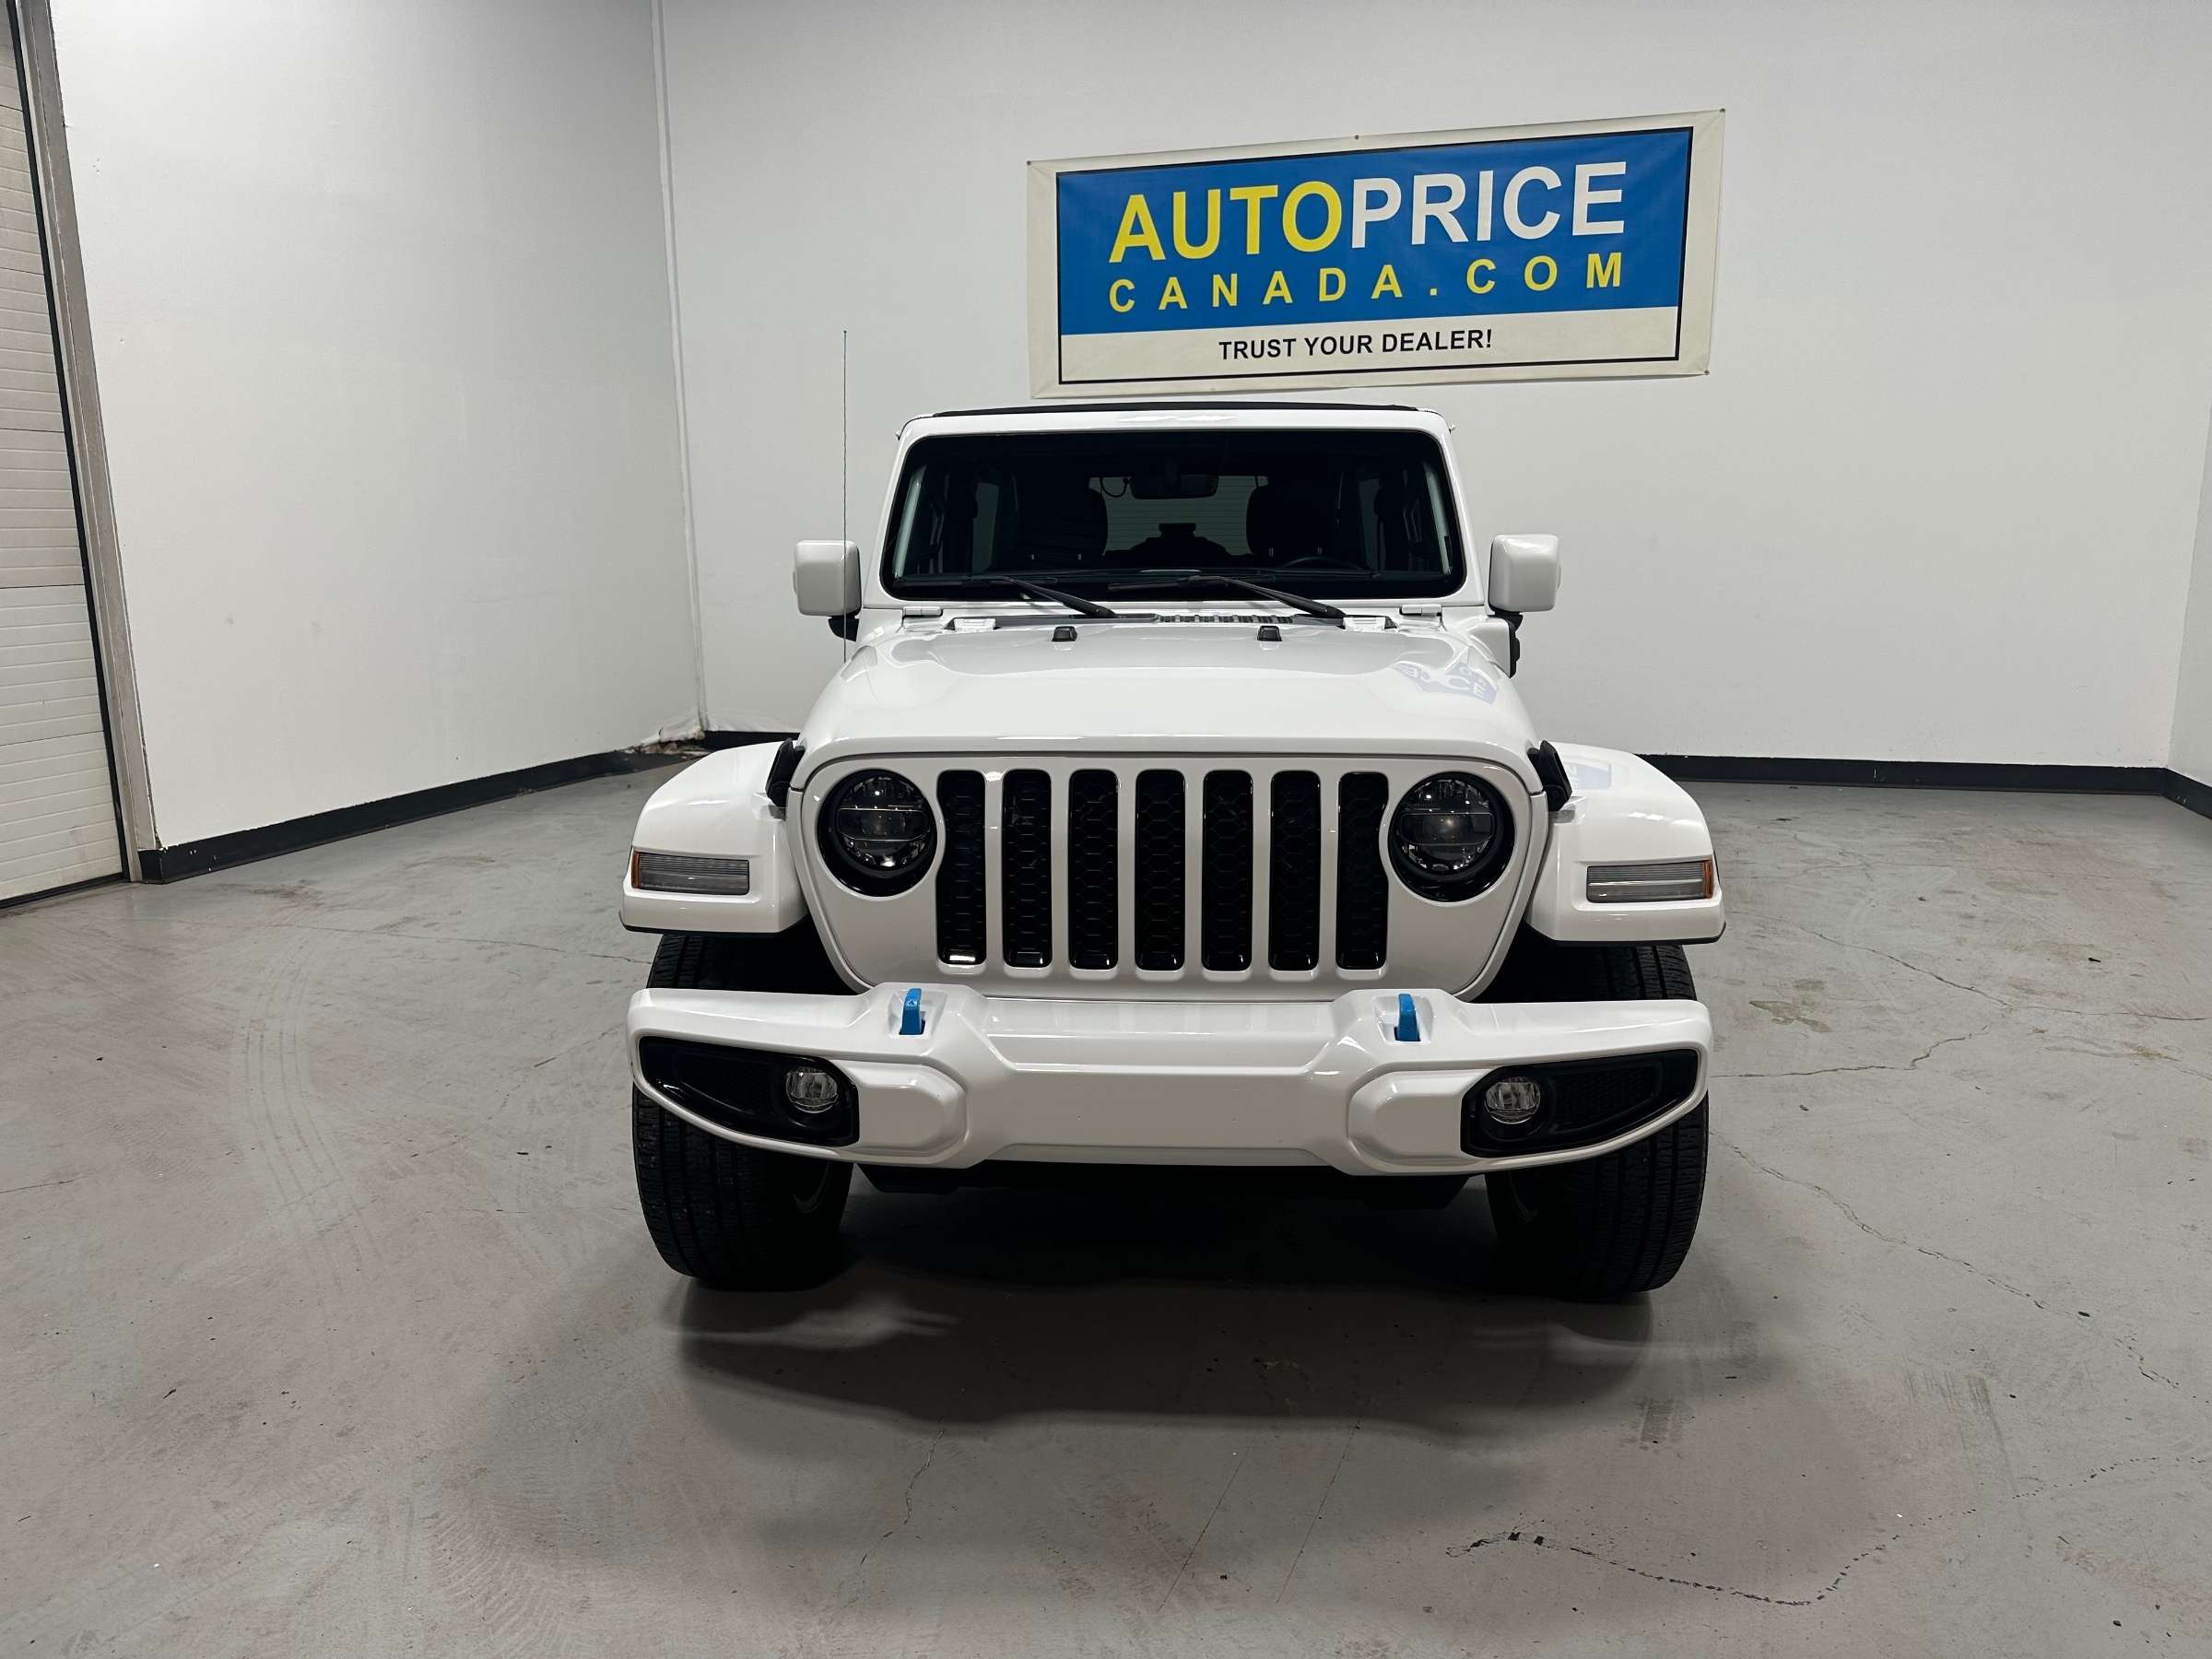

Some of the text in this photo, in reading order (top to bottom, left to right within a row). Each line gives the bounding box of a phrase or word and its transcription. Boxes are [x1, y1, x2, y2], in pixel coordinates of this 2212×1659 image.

[1108, 161, 1627, 264] AUTOPRICE
[1218, 328, 1493, 360] TRUST YOUR DEALER!
